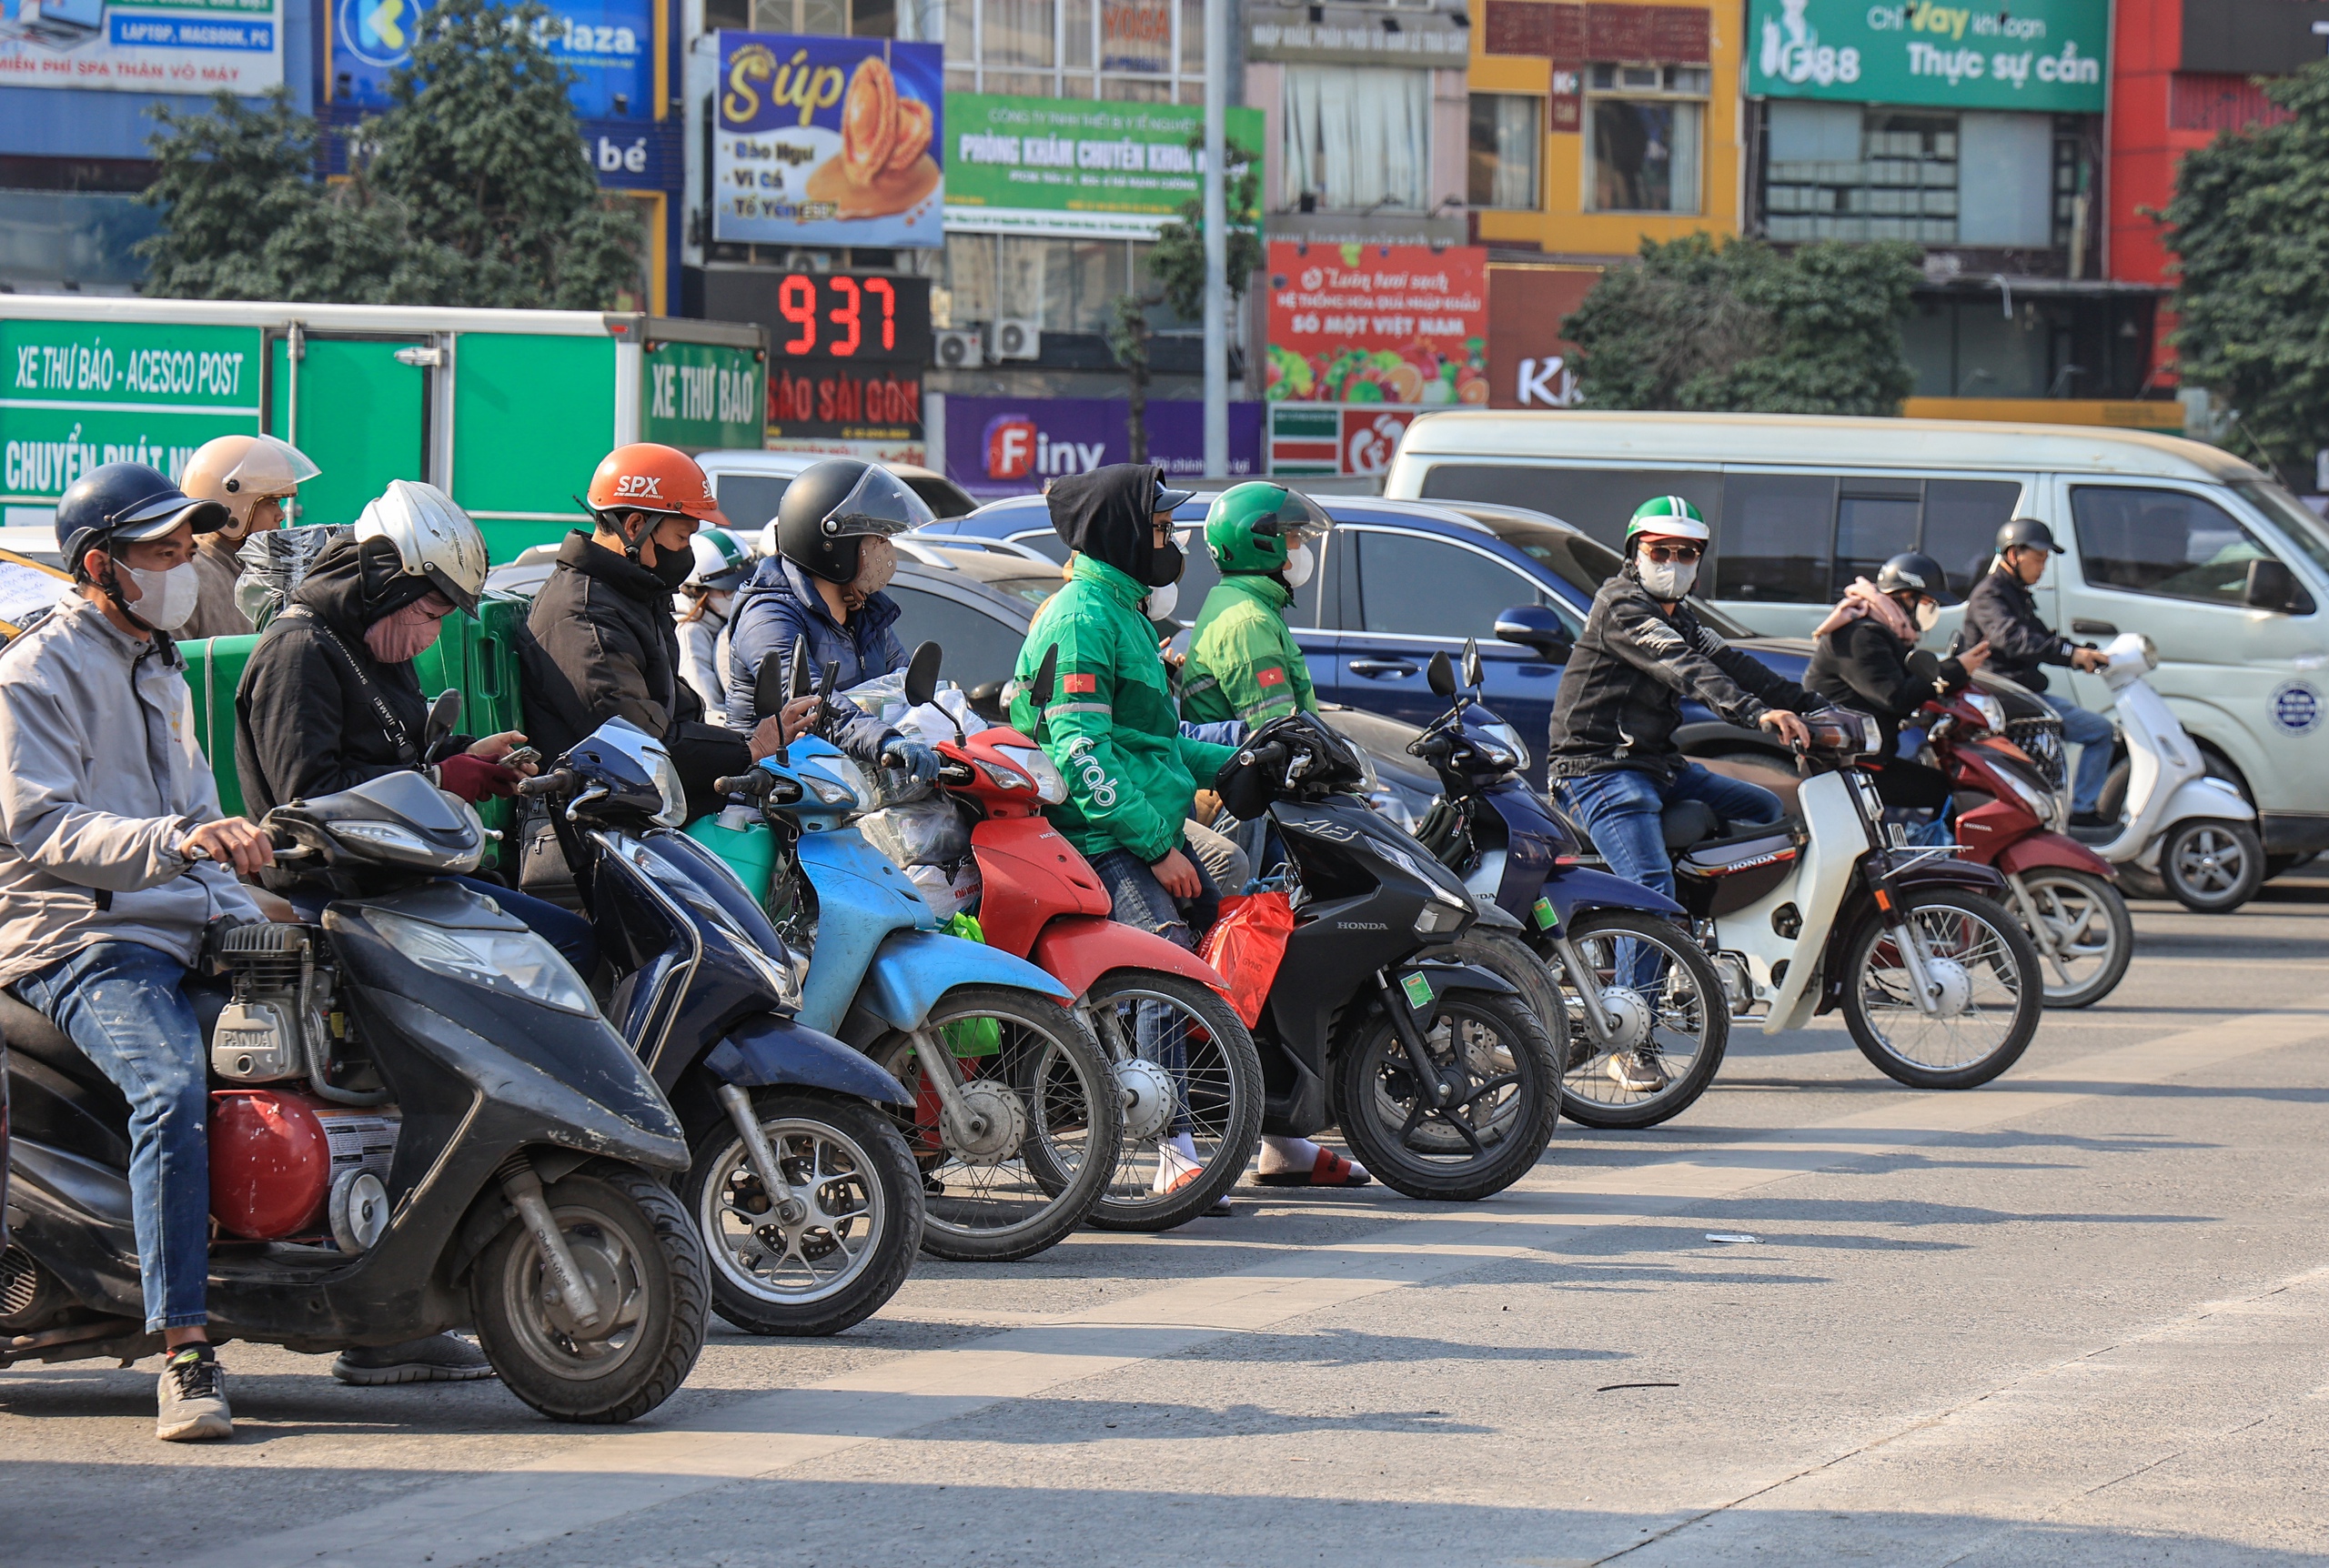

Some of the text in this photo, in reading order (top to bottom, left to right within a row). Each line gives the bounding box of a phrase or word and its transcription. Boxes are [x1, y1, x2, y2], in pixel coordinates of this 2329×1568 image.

[250, 29, 269, 46] PC
[1103, 7, 1170, 42] YOGA
[42, 58, 72, 73] PHÍ
[77, 62, 110, 76] SPA
[1907, 41, 1985, 86] Thực
[1991, 52, 2032, 88] sự
[723, 48, 844, 127] Súp
[598, 136, 649, 173] bé
[960, 127, 1020, 166] PHÒNG
[1023, 131, 1074, 169] KHÁM
[1292, 310, 1466, 339] SỐ MỘT VIỆT NAM
[15, 345, 39, 389] XE
[43, 342, 77, 390] THƯ
[78, 337, 115, 392] BÁO
[126, 349, 194, 397] ACESCO
[197, 351, 244, 396] POST
[651, 358, 754, 425] XE THƯ BÁO
[1003, 428, 1105, 474] Finy
[617, 475, 661, 496] SPX
[1069, 736, 1117, 807] Grab
[1728, 853, 1778, 873] HONDA
[1336, 921, 1389, 930] HONDA
[221, 1030, 273, 1047] PANDA
